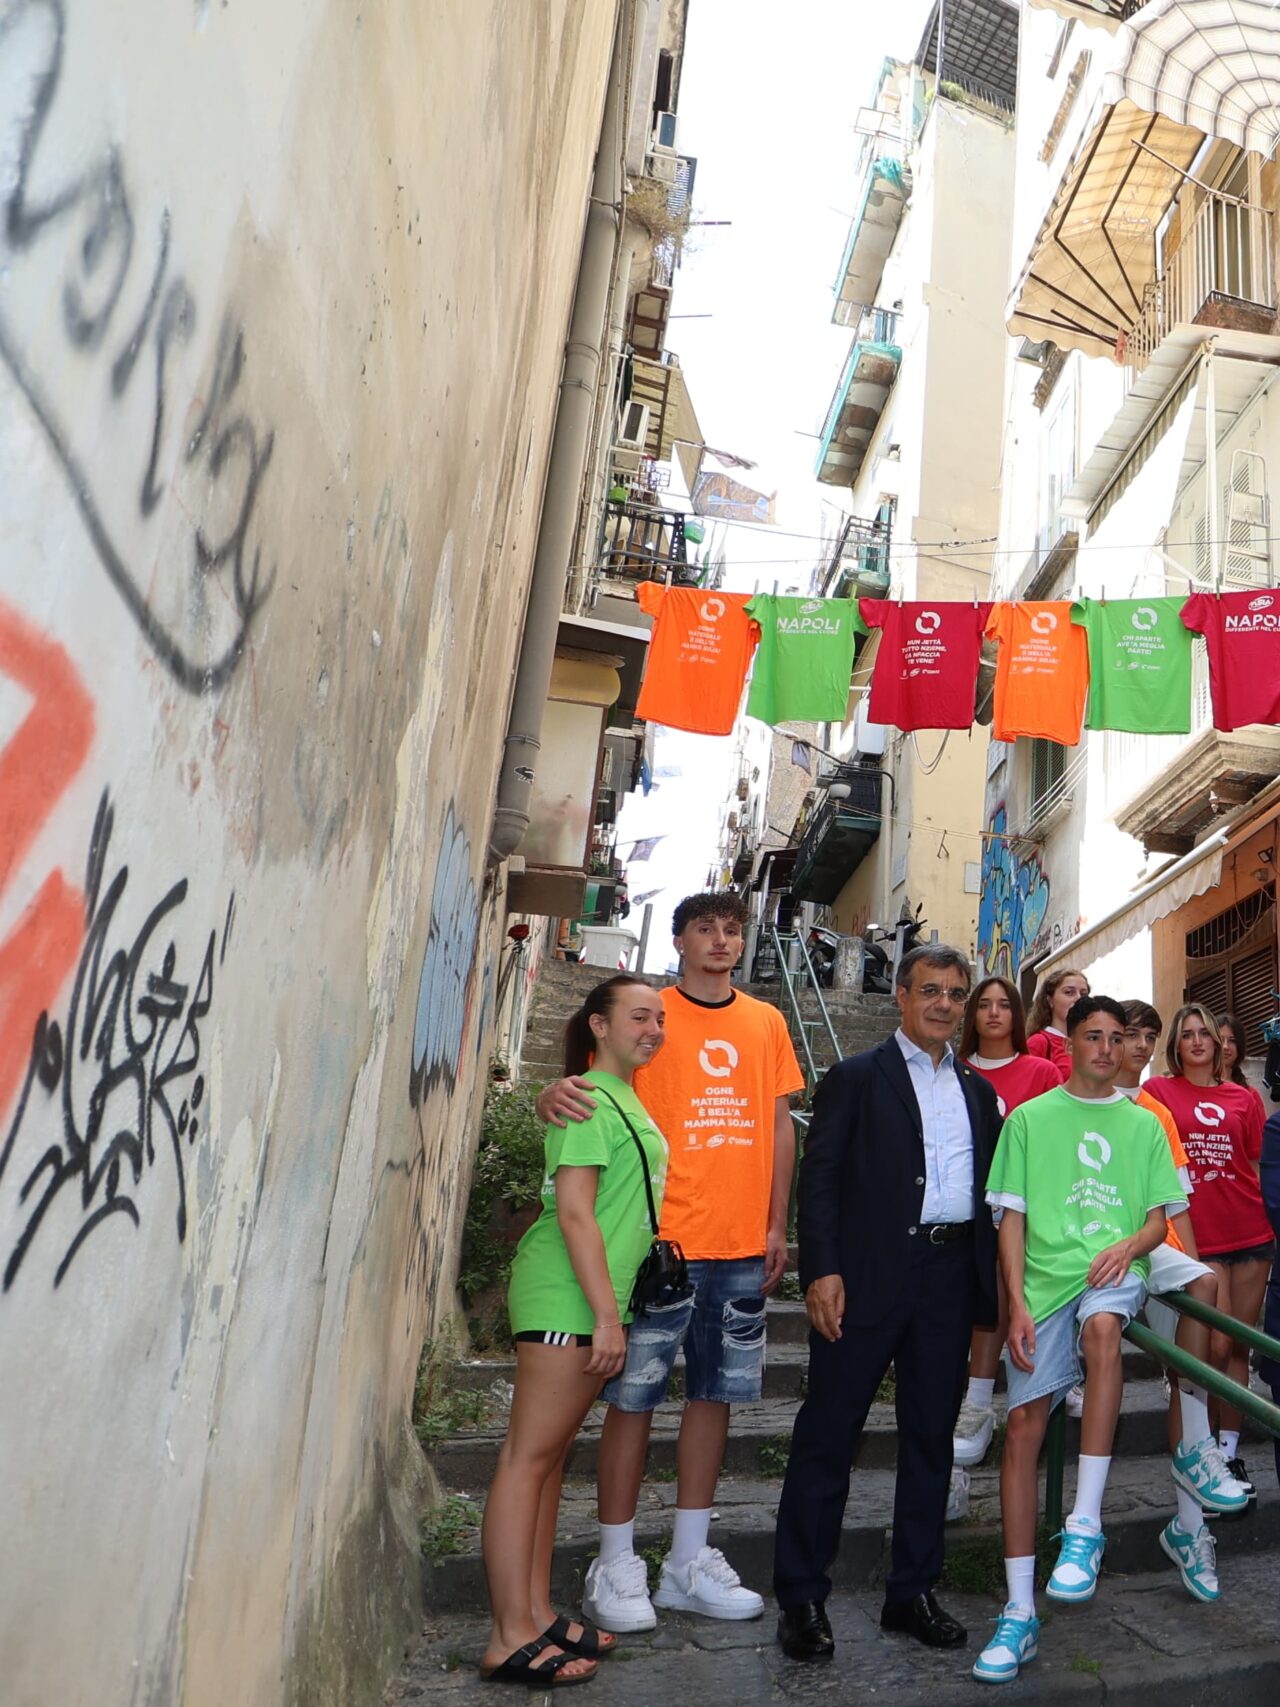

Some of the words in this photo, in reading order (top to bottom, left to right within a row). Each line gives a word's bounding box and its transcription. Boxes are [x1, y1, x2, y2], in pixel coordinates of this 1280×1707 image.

[777, 617, 840, 630] NAPOLI
[705, 1087, 735, 1096] OGNE
[690, 1097, 748, 1106] MATERIALE
[684, 1118, 727, 1129] MAMMA
[728, 1119, 755, 1128] SOJA!
[1188, 1132, 1205, 1140] NUN
[1206, 1134, 1231, 1143] JETTÀ
